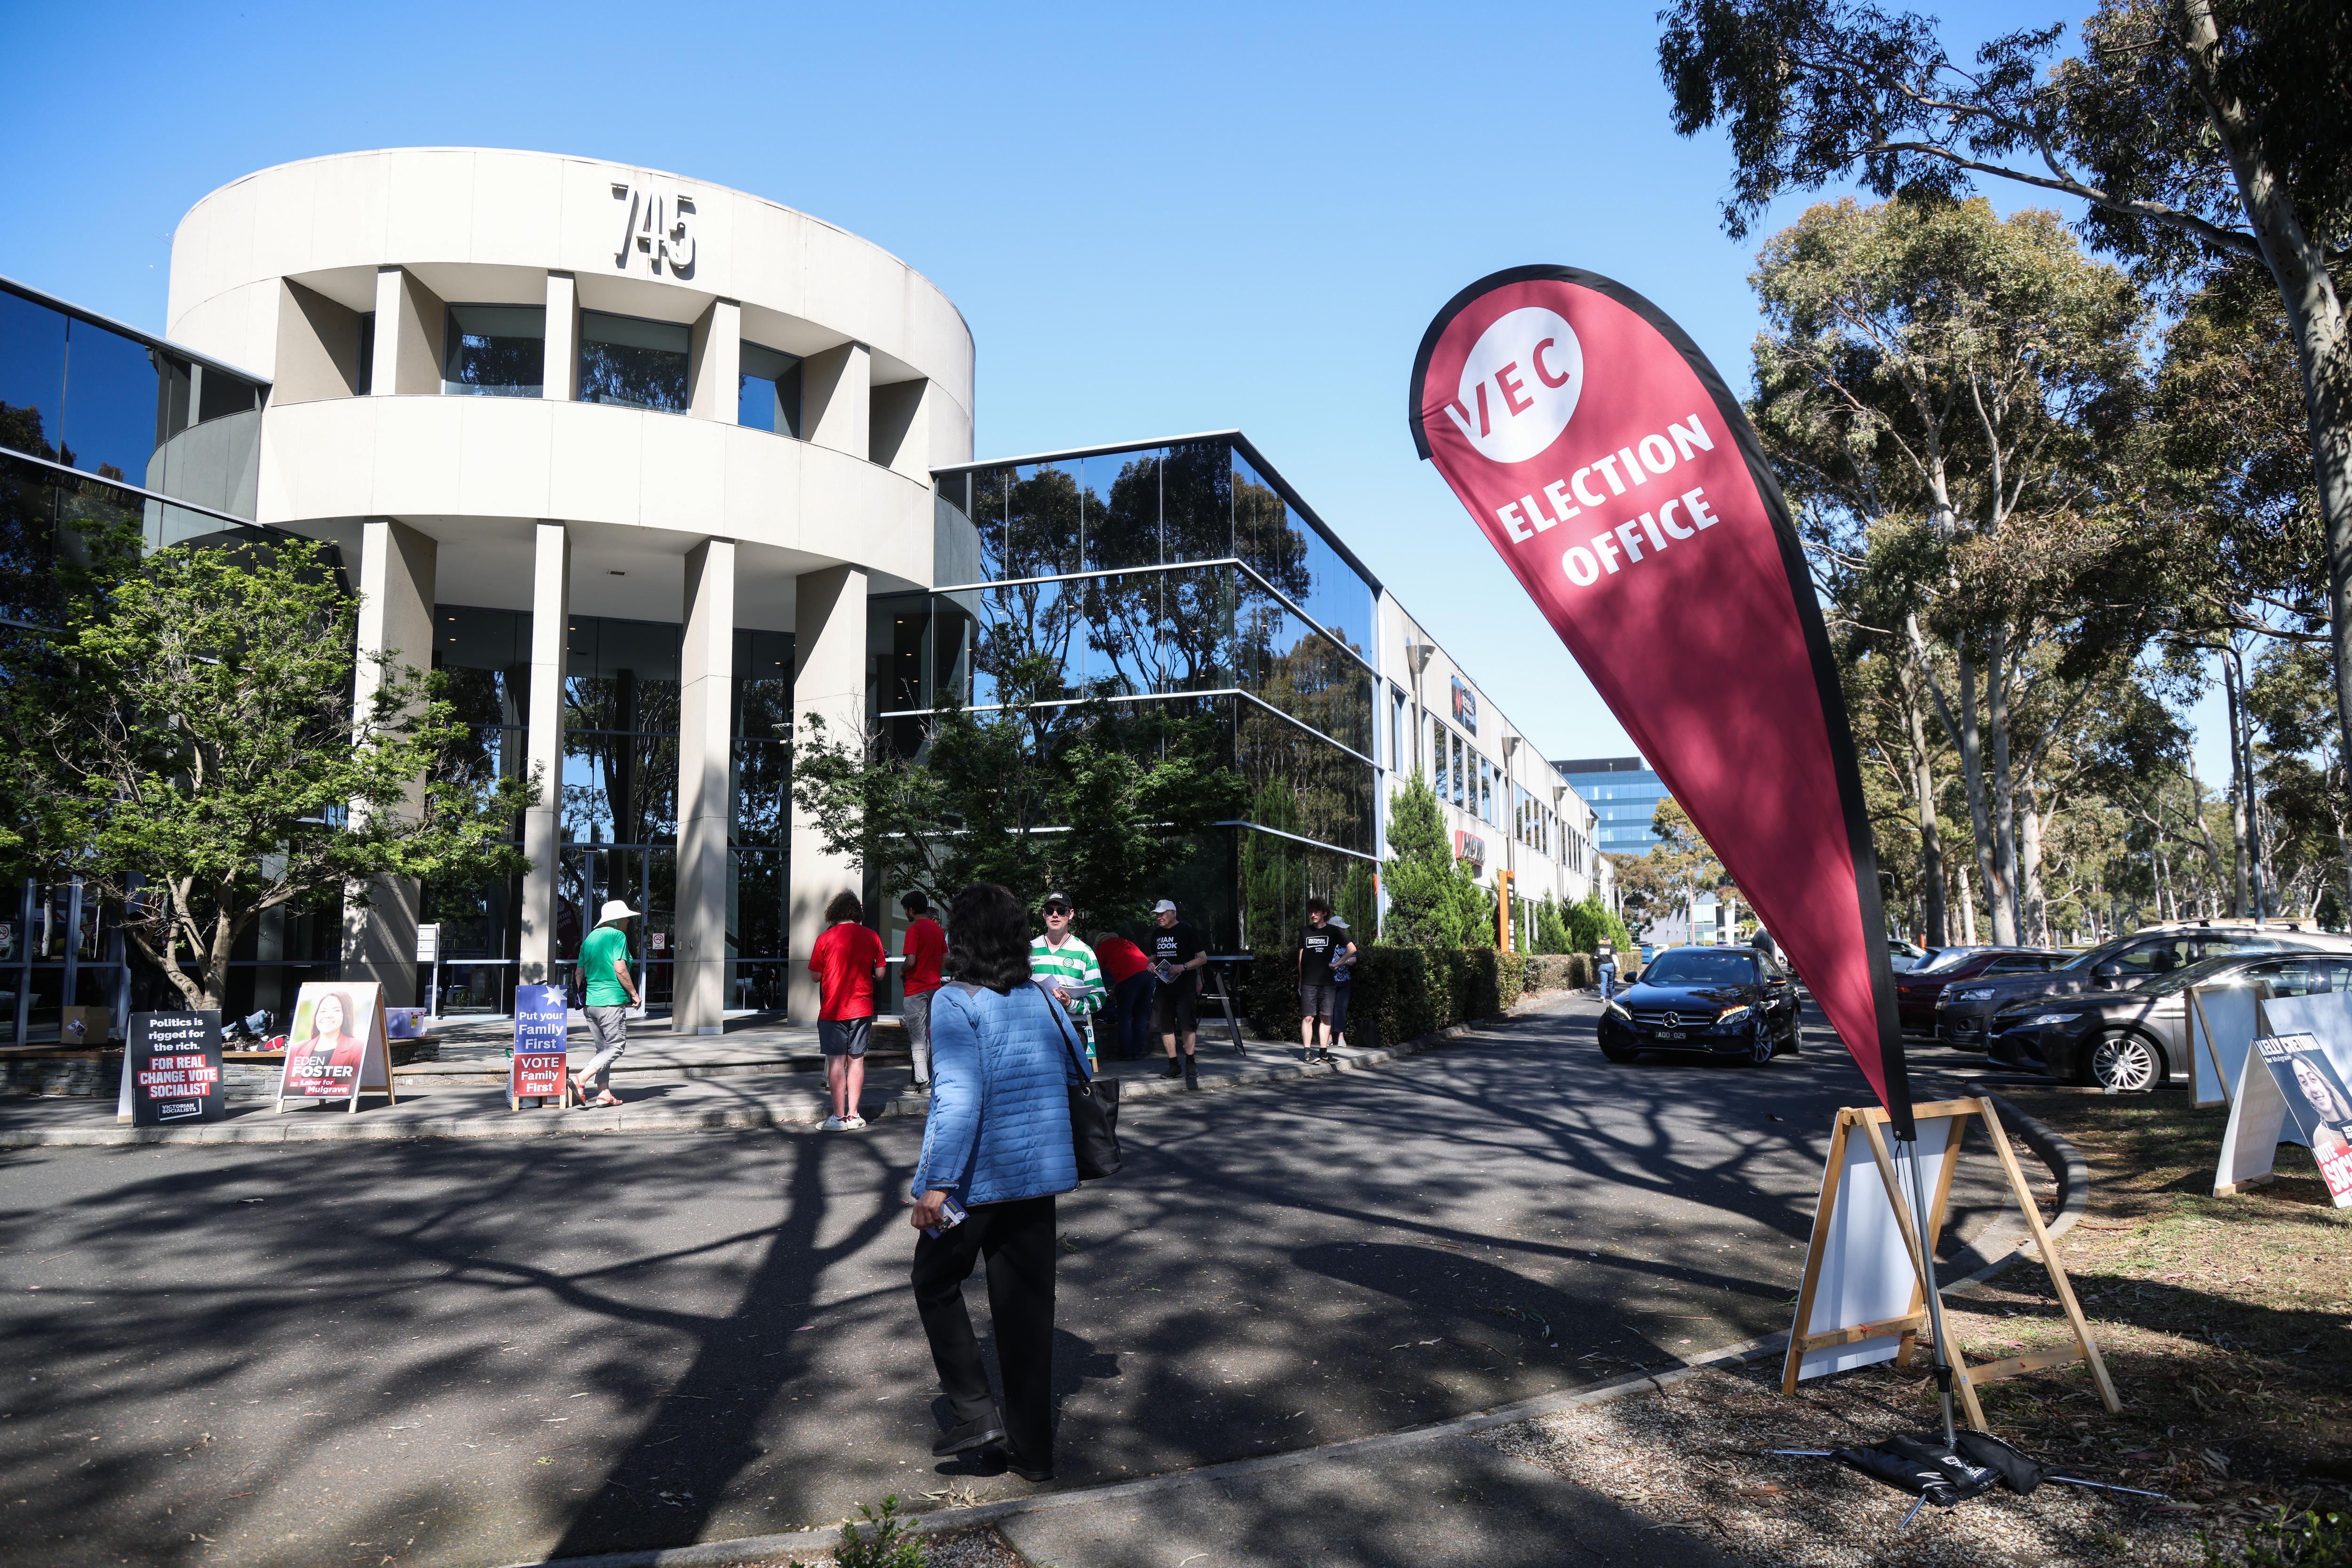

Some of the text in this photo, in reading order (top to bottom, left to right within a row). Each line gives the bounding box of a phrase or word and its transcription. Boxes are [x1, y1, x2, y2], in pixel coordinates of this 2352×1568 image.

[611, 178, 695, 267] 745
[1444, 337, 1570, 439] VEC
[1496, 413, 1715, 545] ELECTION
[1562, 486, 1720, 586] OFFICE
[150, 1018, 204, 1028] Politics is
[519, 1012, 564, 1022] Put your
[149, 1029, 205, 1041] rigged for
[519, 1023, 564, 1037] Family
[154, 1042, 200, 1052] the rich.
[525, 1038, 556, 1049] First
[2255, 1037, 2285, 1056] KELLY
[152, 1056, 204, 1070] FOR REAL
[294, 1056, 326, 1065] EDEN
[521, 1057, 559, 1068] VOTE
[140, 1069, 216, 1085] CHANGE VOTE
[291, 1065, 353, 1077] FOSTER
[521, 1070, 559, 1081] Family
[150, 1083, 207, 1098] SOCIALIST
[307, 1085, 348, 1094] Mulgrave
[526, 1083, 553, 1093] First
[2312, 1140, 2339, 1164] VOTE
